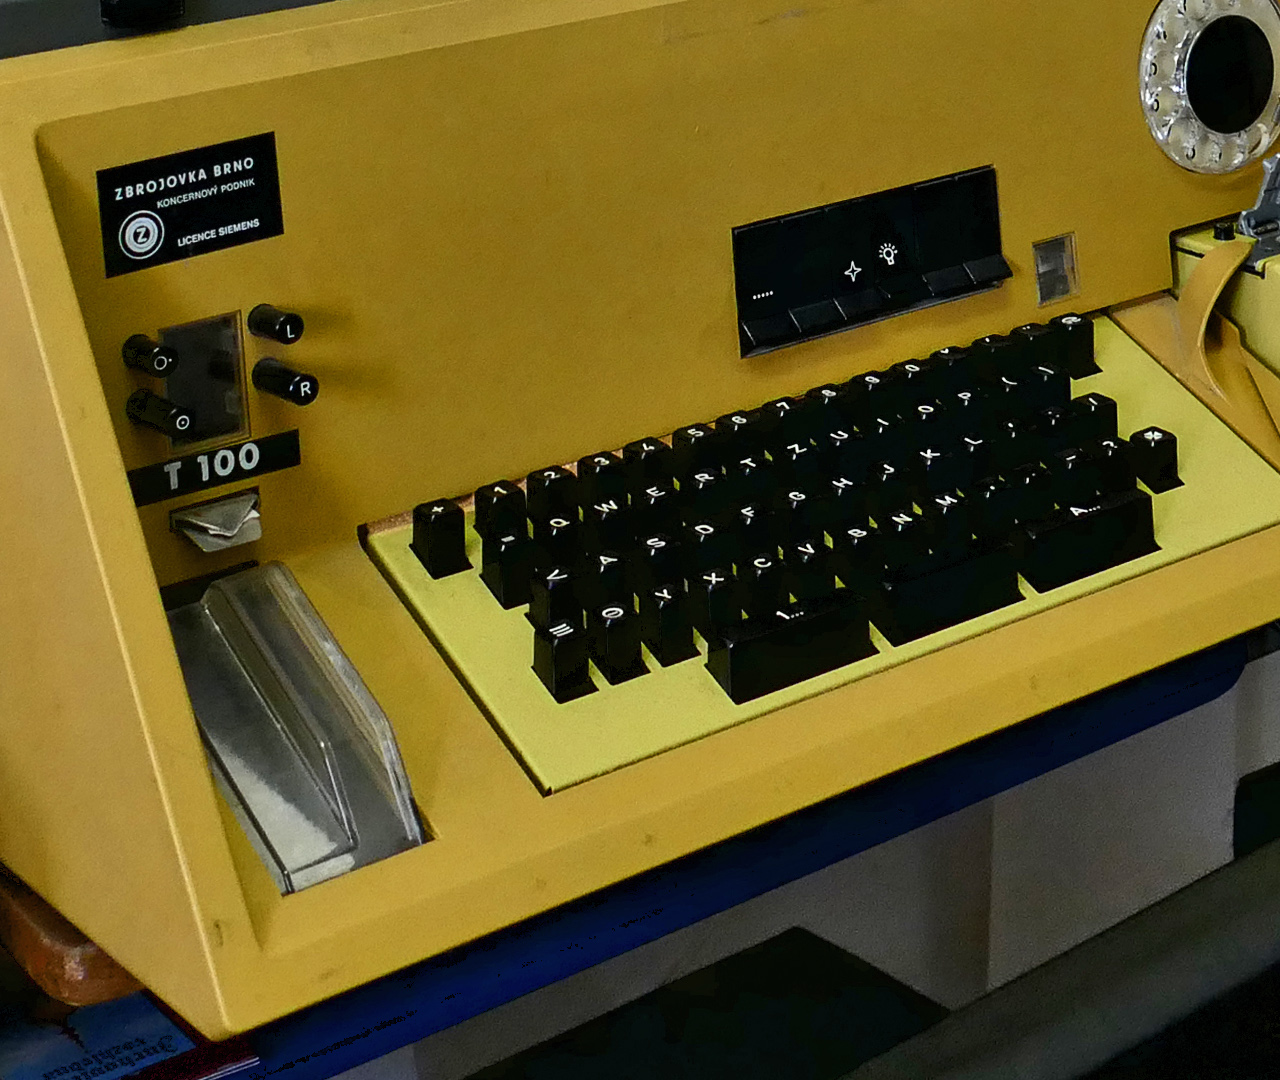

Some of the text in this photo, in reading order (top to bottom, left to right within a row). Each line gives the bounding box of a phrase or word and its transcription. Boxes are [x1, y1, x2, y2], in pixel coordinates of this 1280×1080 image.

[114, 155, 255, 201] ZBROJOVKA BRNO
[156, 177, 256, 210] KONCERNOVÝ PODNIK
[176, 217, 261, 248] LICENCE SIEMENS
[286, 323, 296, 339] L
[299, 380, 312, 398] R
[163, 441, 261, 491] T 100
